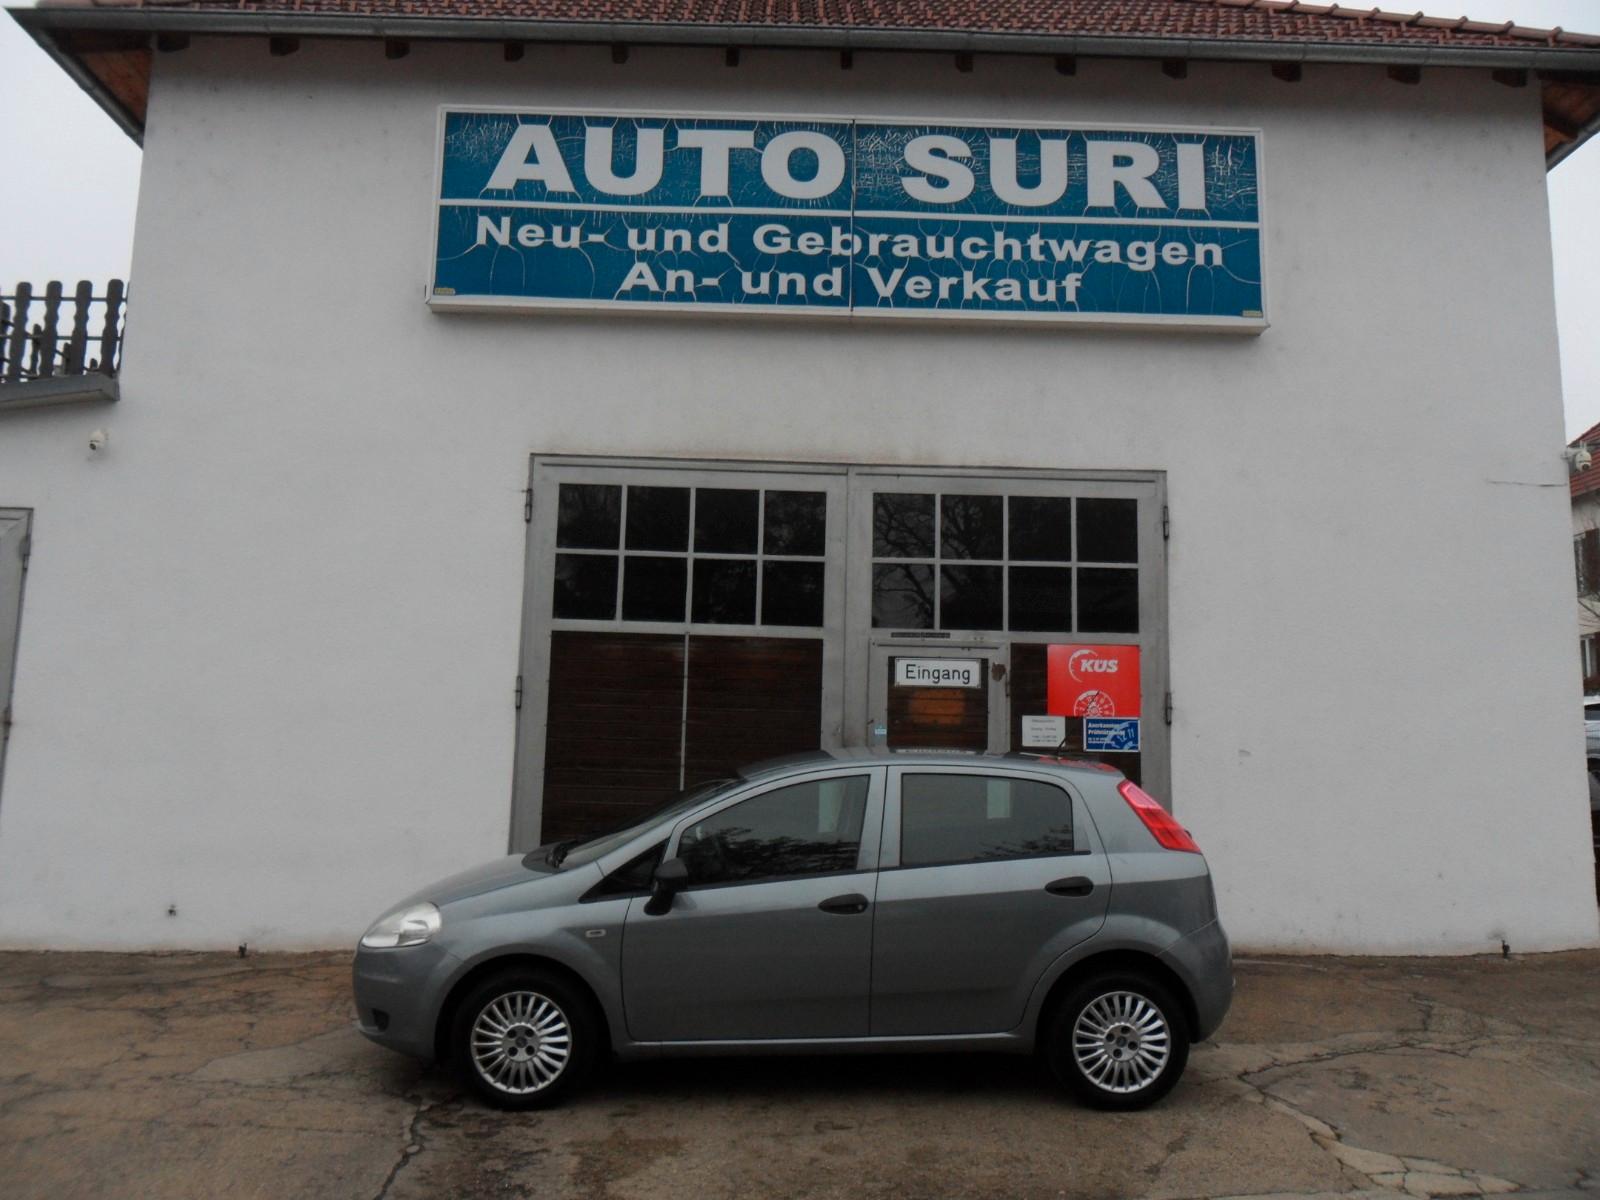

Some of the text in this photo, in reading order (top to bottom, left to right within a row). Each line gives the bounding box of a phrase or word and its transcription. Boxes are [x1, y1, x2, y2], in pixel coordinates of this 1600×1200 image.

[485, 123, 1206, 210] AUTO SURI
[475, 215, 1223, 271] Neu- und Gebrauchtwagen
[620, 261, 1082, 302] An- und Verkauf
[905, 663, 971, 685] Eingang
